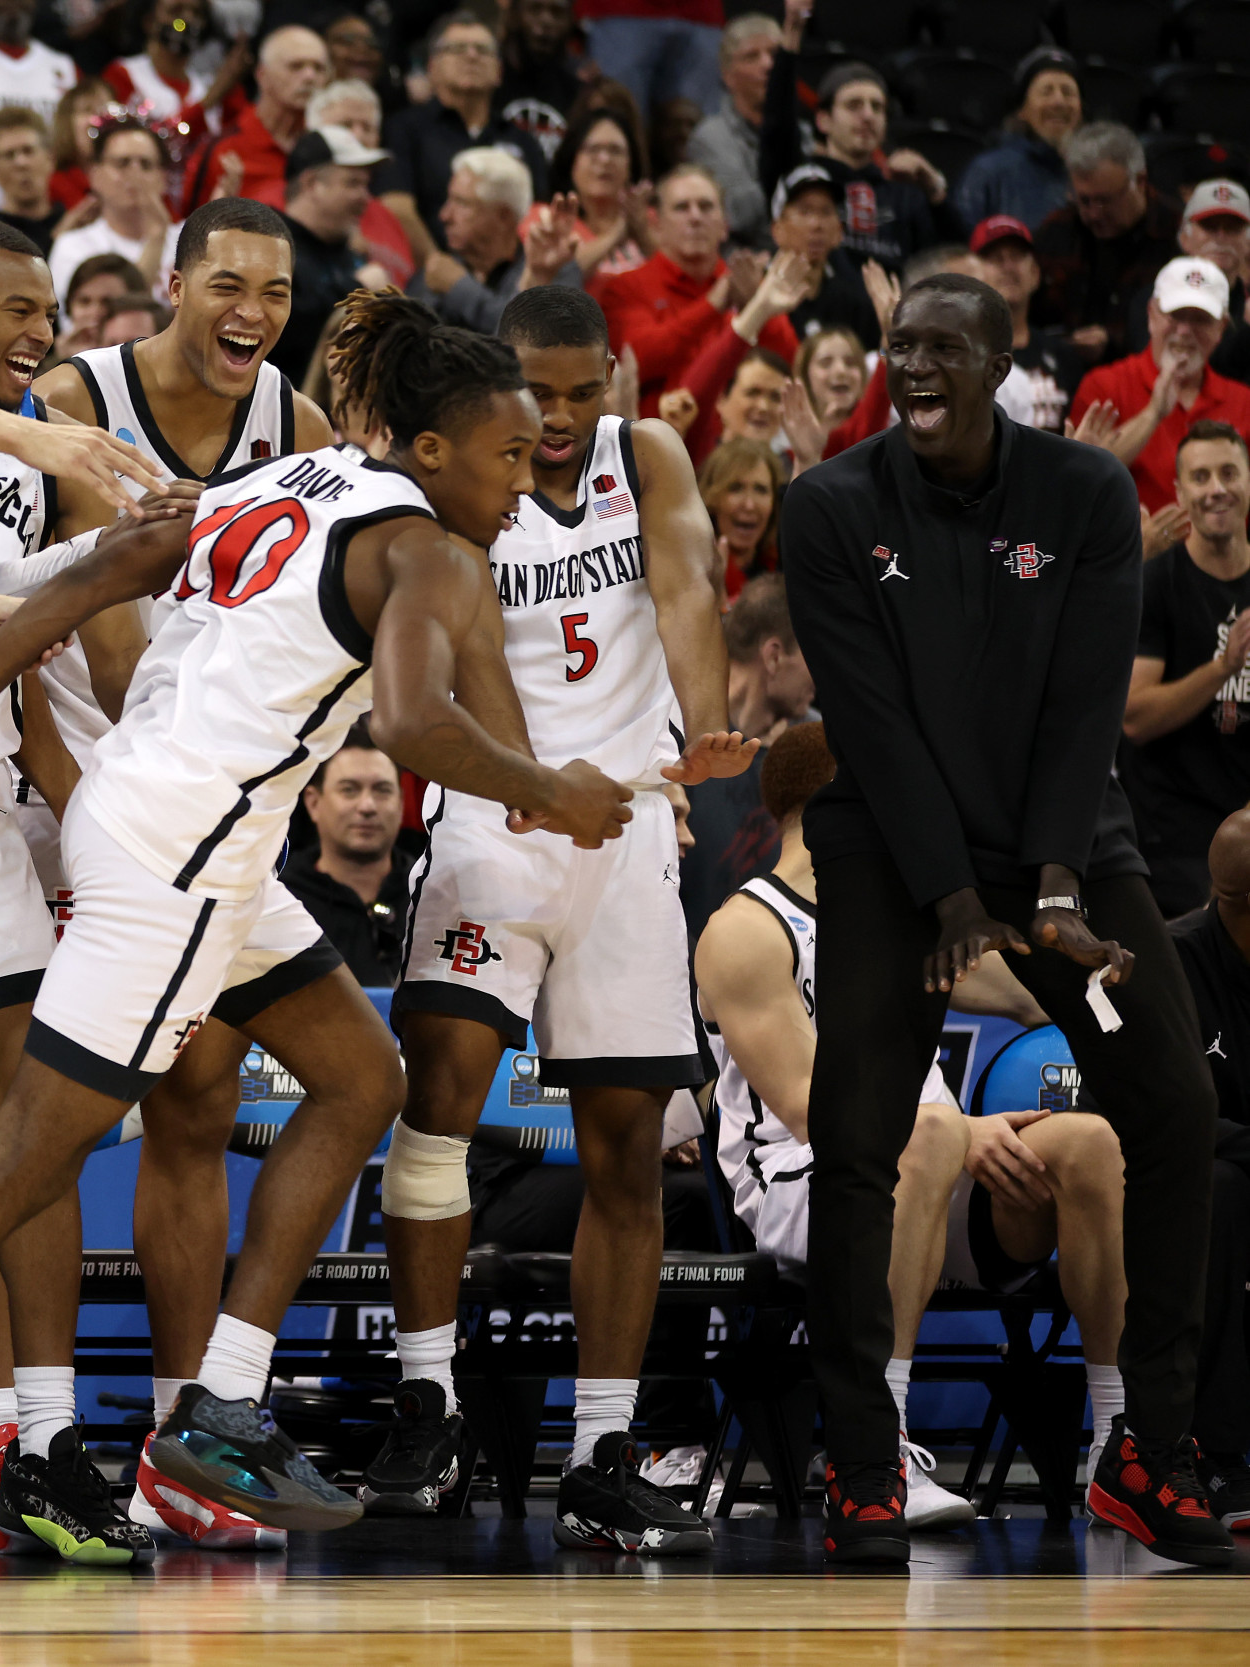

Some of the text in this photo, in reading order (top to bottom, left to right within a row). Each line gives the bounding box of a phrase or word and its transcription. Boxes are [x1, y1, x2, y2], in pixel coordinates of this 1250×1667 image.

[173, 495, 311, 609] 10
[560, 612, 599, 683] 5
[98, 1262, 122, 1276] THE
[306, 1264, 324, 1279] HE
[325, 1264, 358, 1279] ROAD
[360, 1264, 377, 1279] TO
[659, 1266, 746, 1281] HE FINAL FOUR
